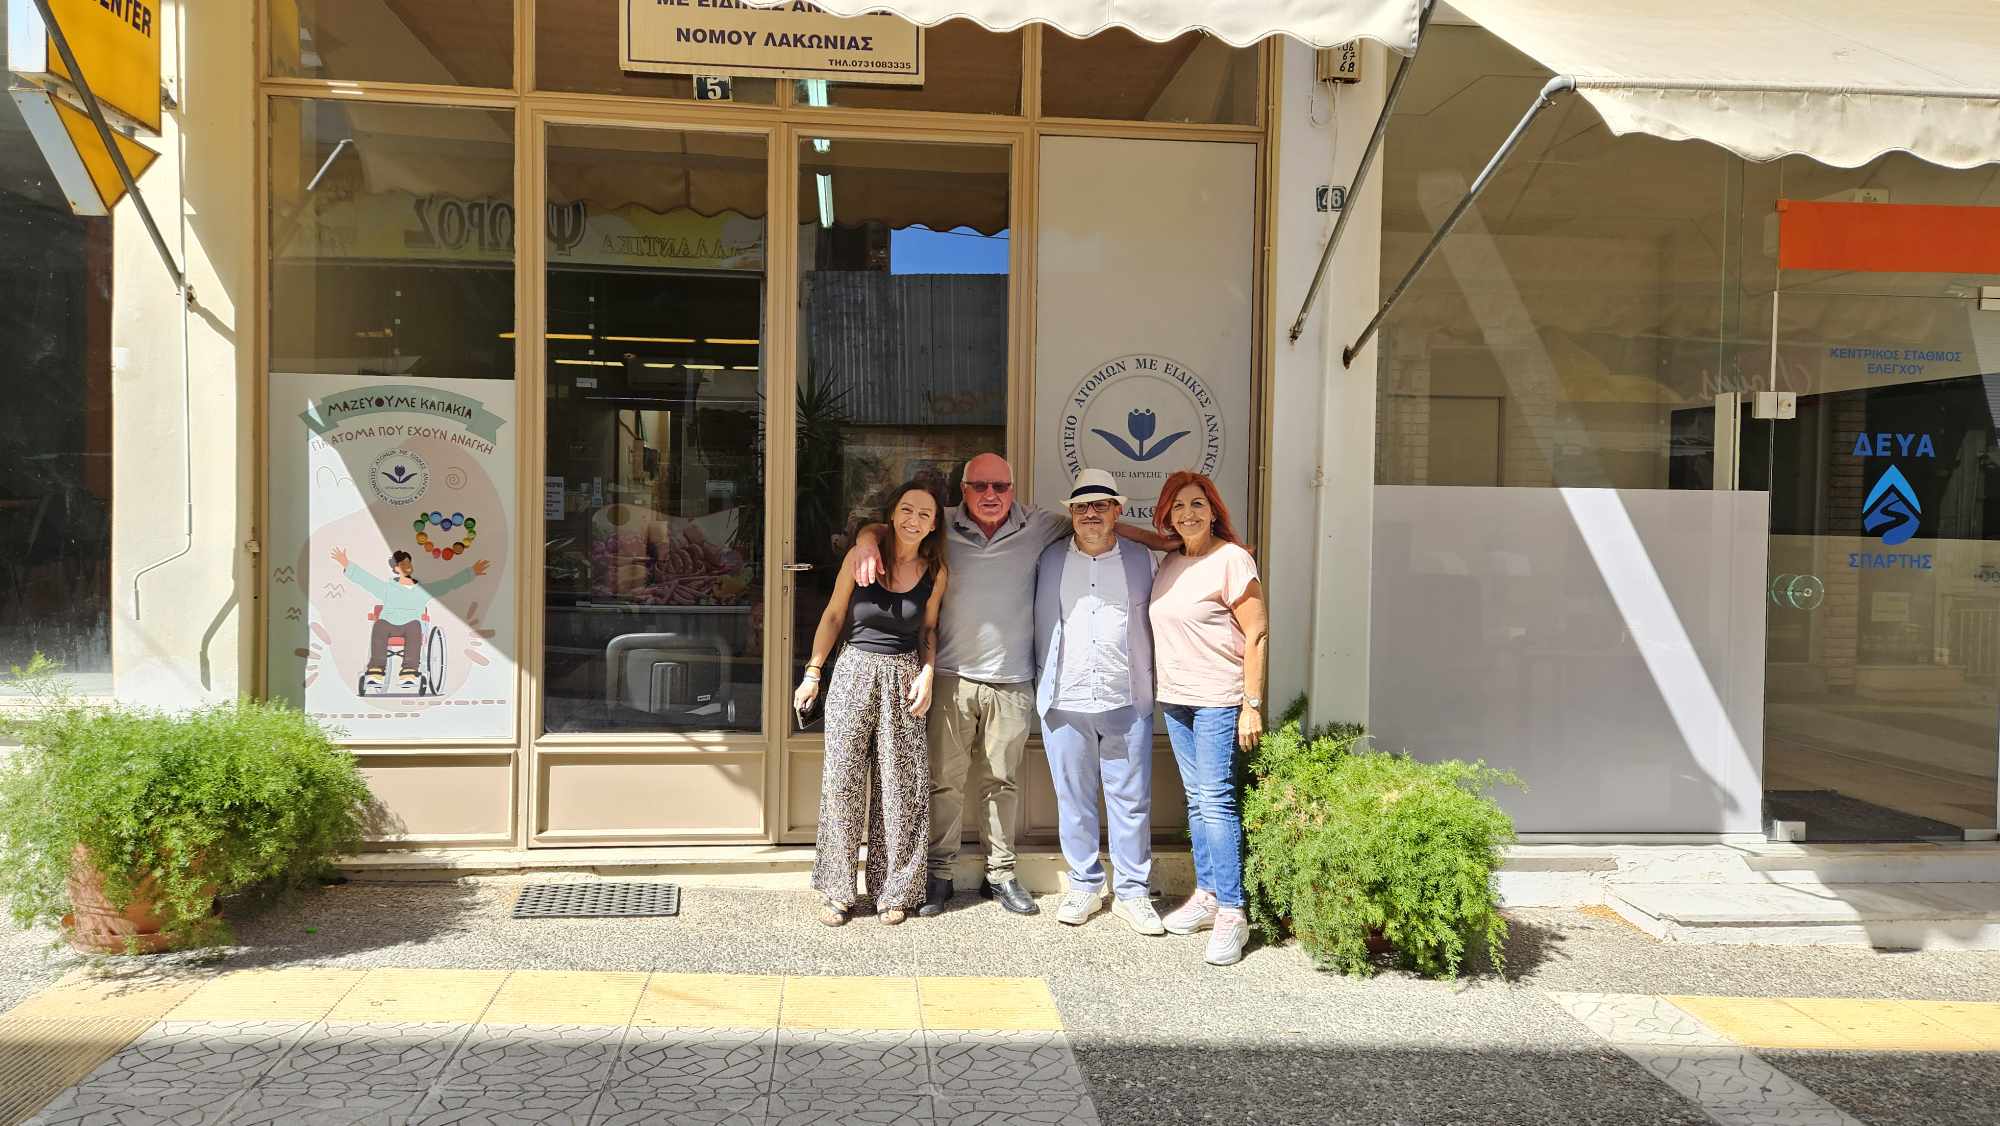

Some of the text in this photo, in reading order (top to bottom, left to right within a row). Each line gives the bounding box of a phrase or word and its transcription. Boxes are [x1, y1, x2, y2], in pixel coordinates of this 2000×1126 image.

[675, 27, 874, 51] ΝΟΜΟΥ ΛΑΚΩΝΙΑΣ
[828, 58, 912, 69] ΤΗΛ.0731083335
[1829, 347, 1963, 362] ΚΕΝΤΡΙΚΟΣ ΣΤΑΘΜΟΣ
[1866, 363, 1925, 376] ΕΛΕΓΧΟΥ
[1074, 361, 1127, 408] ΑΤΟΜΩΝ
[1135, 358, 1159, 371] ΜΕ
[1164, 362, 1212, 408] ΕΙΔΙΚΕΣ
[328, 396, 473, 419] ΜΑΖΕΥΟΥΜΕ ΚΑΠΑΚΙΑ
[331, 427, 376, 444] ΑΤΟΜΑ
[378, 424, 404, 437] ΠΟΥ
[407, 426, 448, 441] ΕΧΟΥΝ
[450, 434, 494, 455] ΑΝΑΓΚΗ
[1852, 432, 1937, 458] ΔΕΥΑ
[1848, 553, 1933, 569] ΣΠΑΡΤΗΣ
